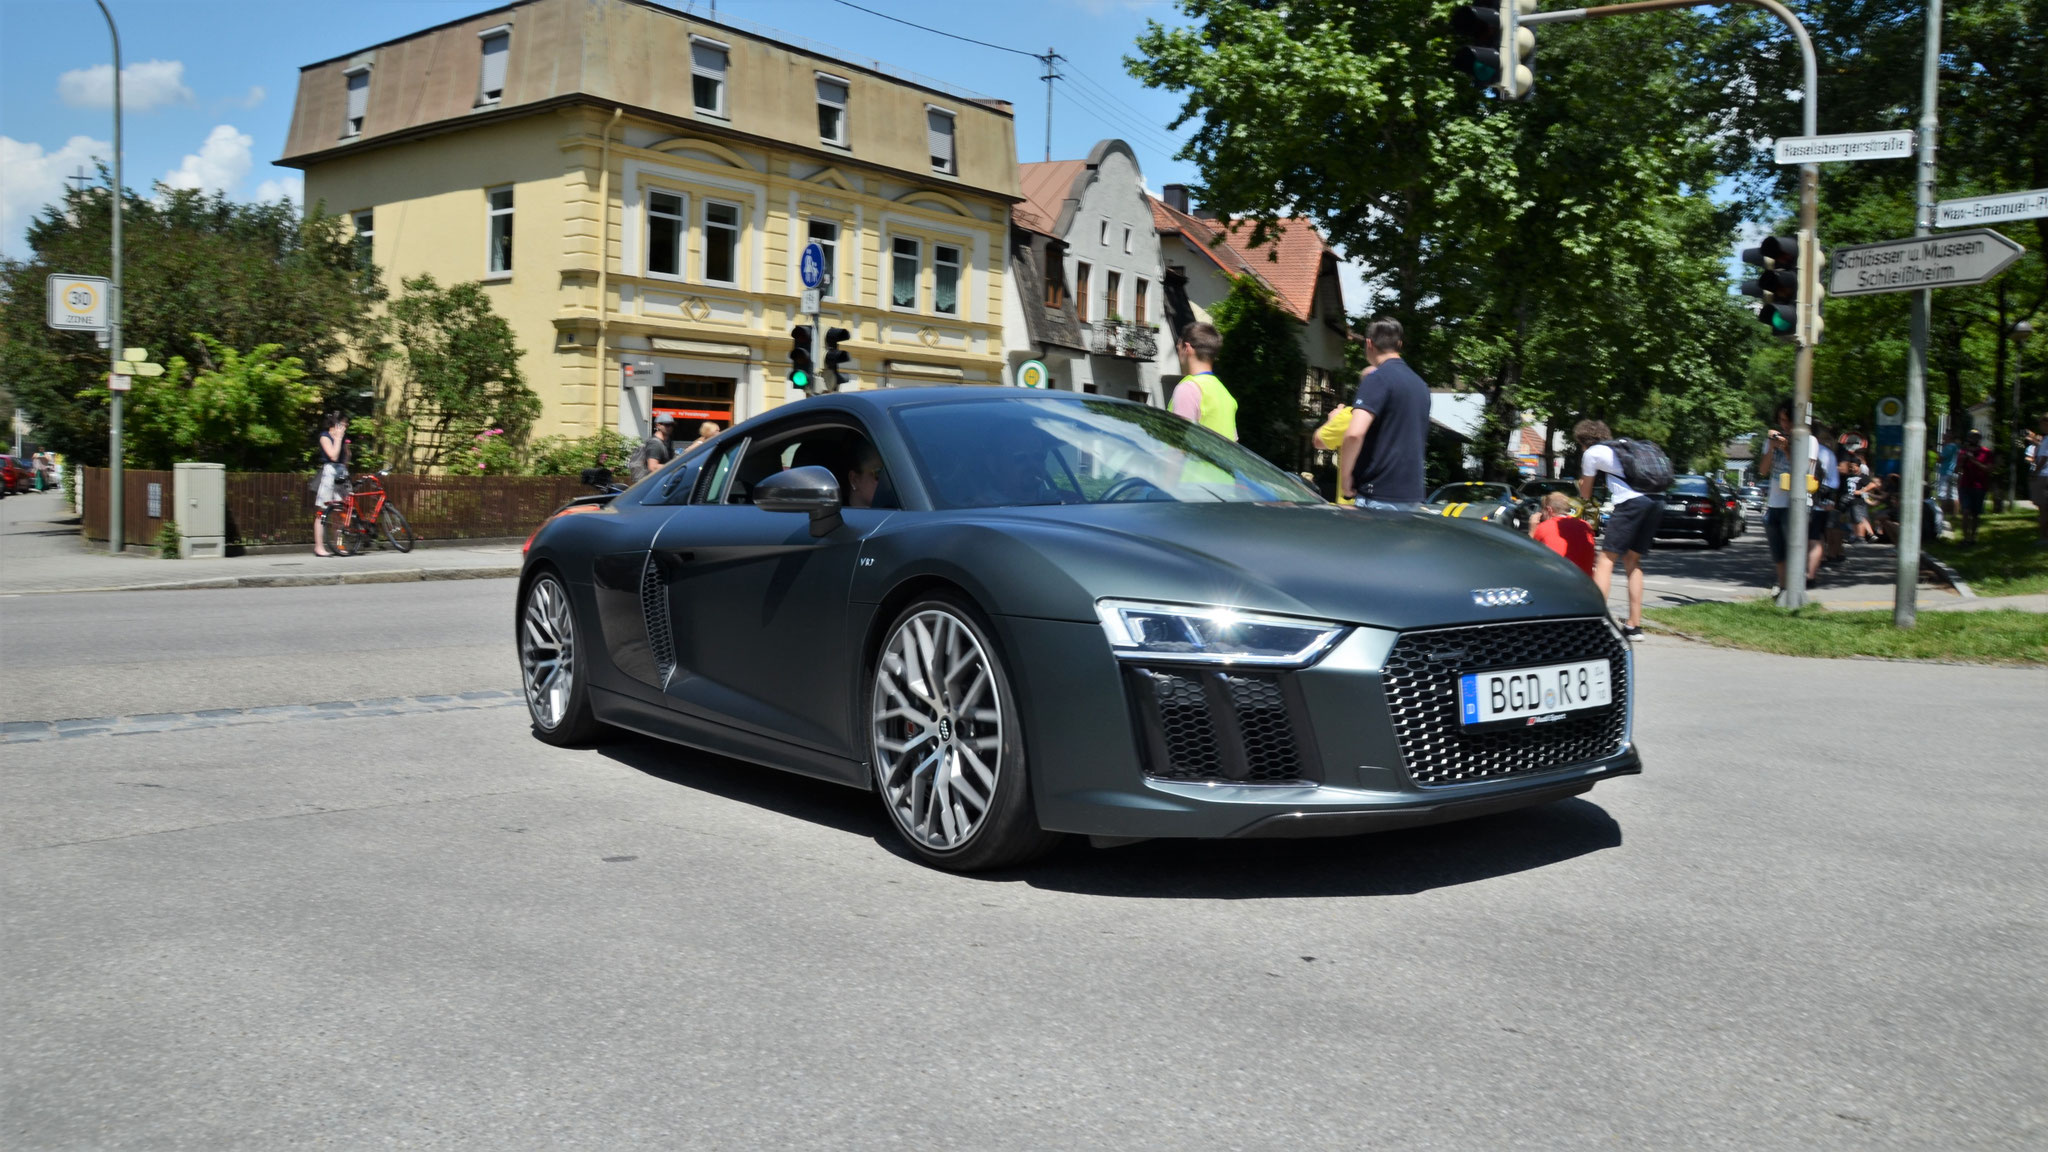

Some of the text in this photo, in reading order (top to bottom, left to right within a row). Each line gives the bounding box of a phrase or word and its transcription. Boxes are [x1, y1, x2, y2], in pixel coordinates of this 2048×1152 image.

[1836, 249, 1906, 270] Schlösser
[1922, 238, 1985, 262] Museen
[1857, 262, 1955, 288] Schleißheim
[68, 290, 93, 306] 30
[65, 314, 94, 325] ZONE
[1491, 673, 1541, 713] BGD
